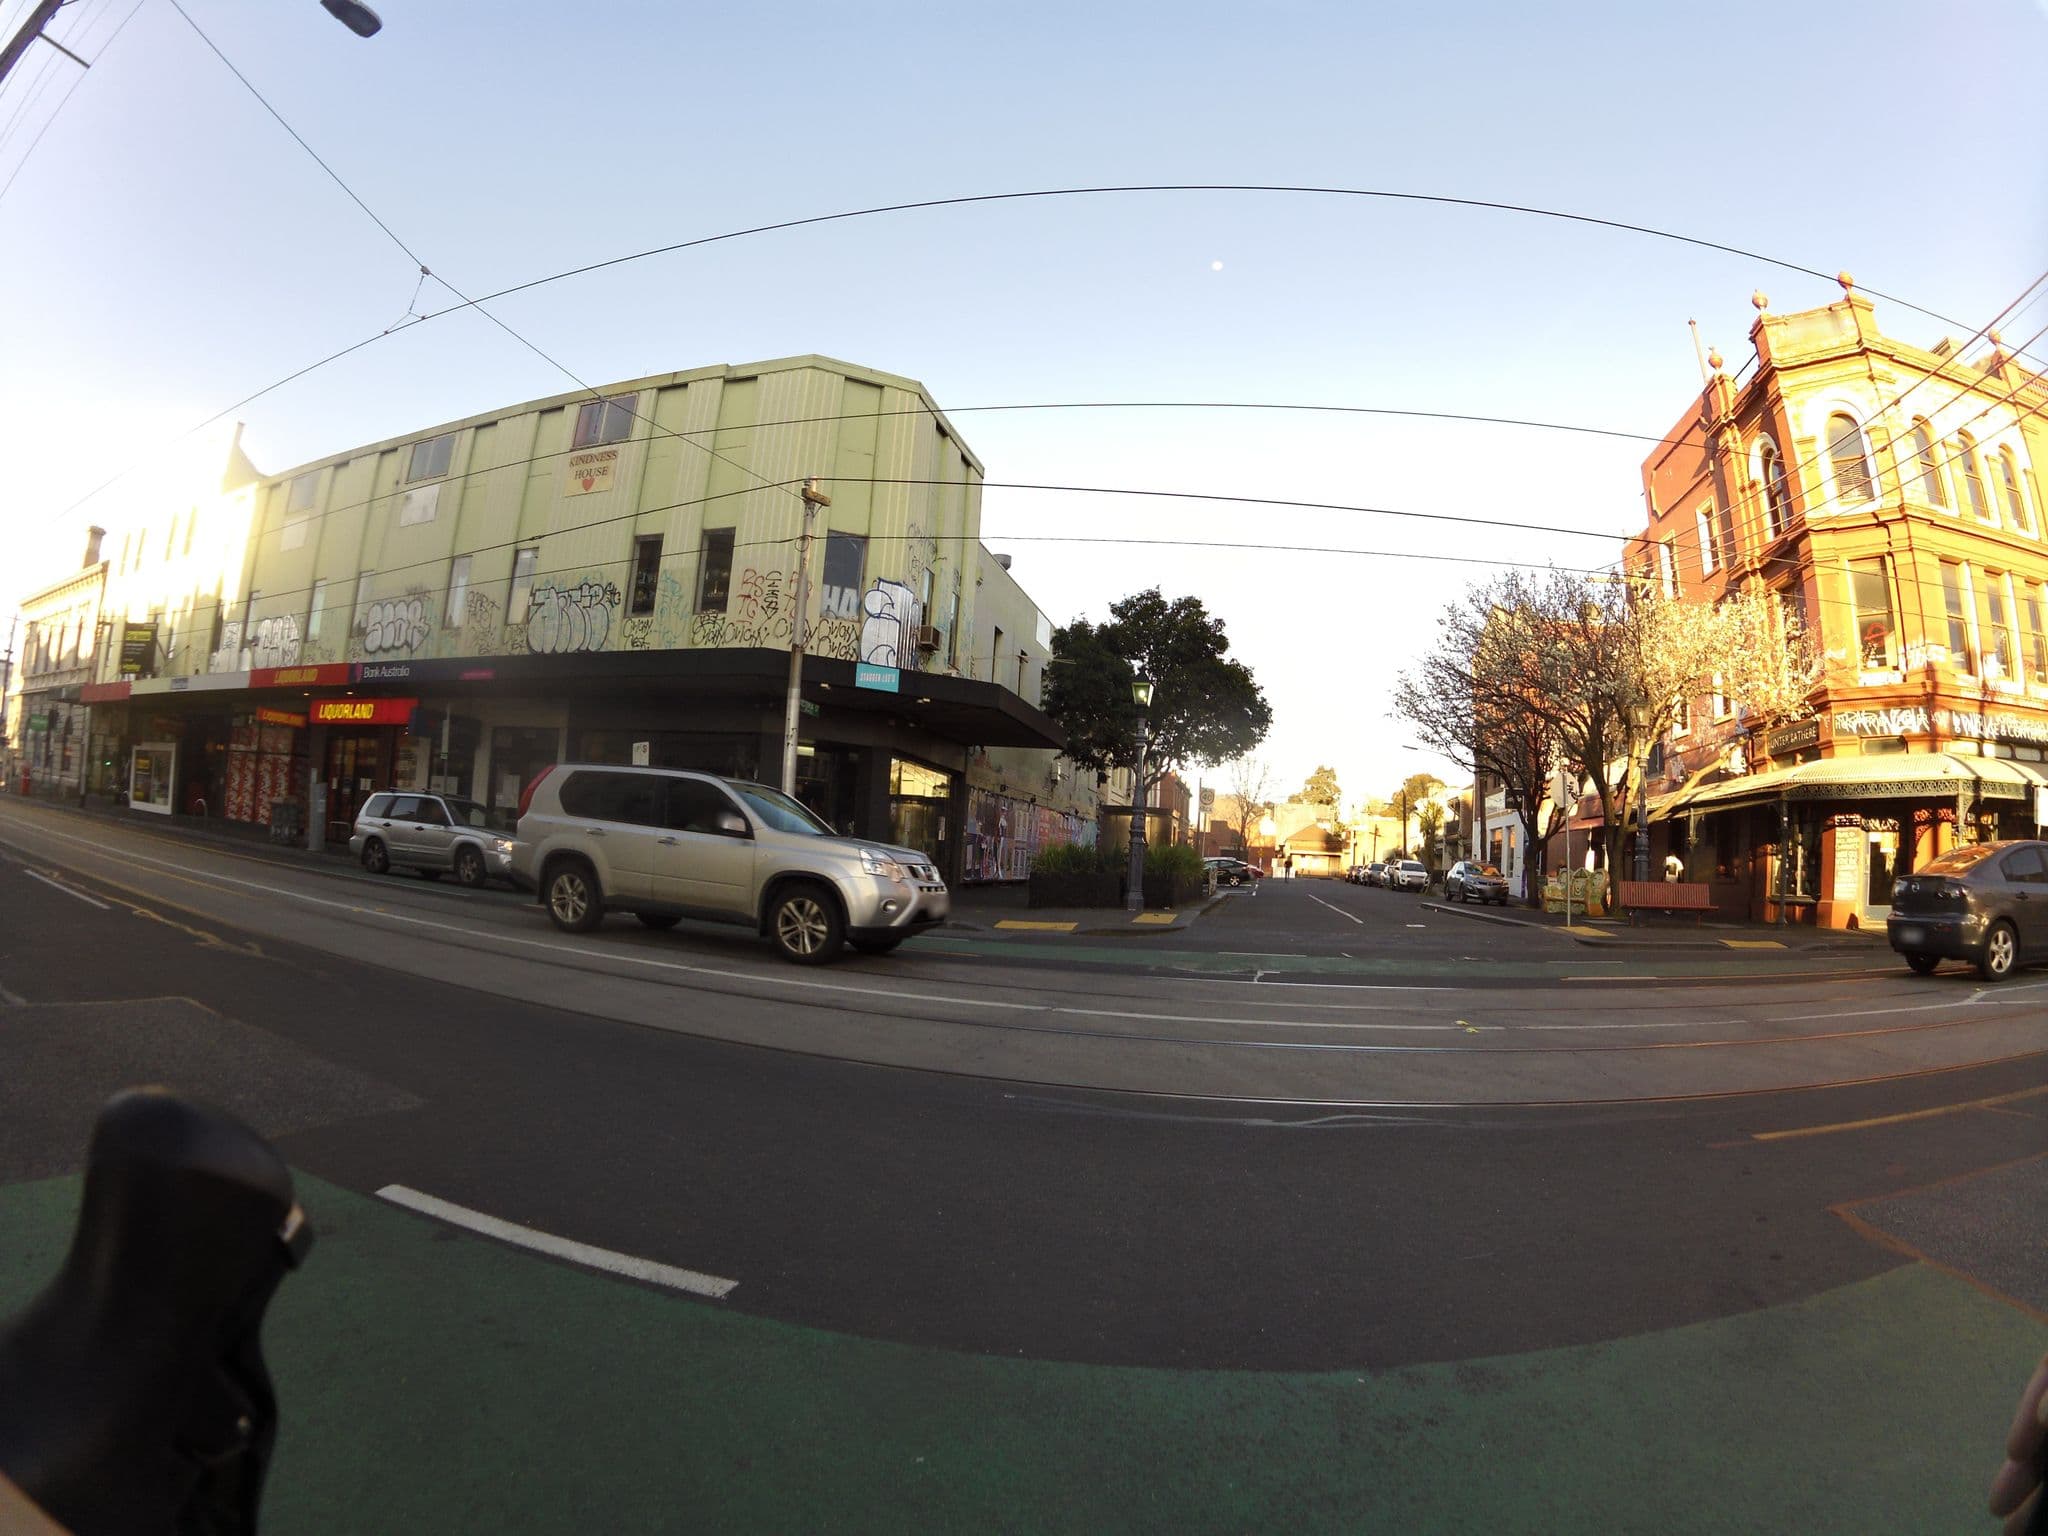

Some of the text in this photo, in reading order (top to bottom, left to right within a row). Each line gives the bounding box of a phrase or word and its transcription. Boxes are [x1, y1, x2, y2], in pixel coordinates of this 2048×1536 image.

[569, 450, 617, 467] KINDNESS
[575, 466, 608, 480] HOUSE
[363, 666, 410, 678] Bank Australia
[319, 703, 374, 720] LIQUORLAND
